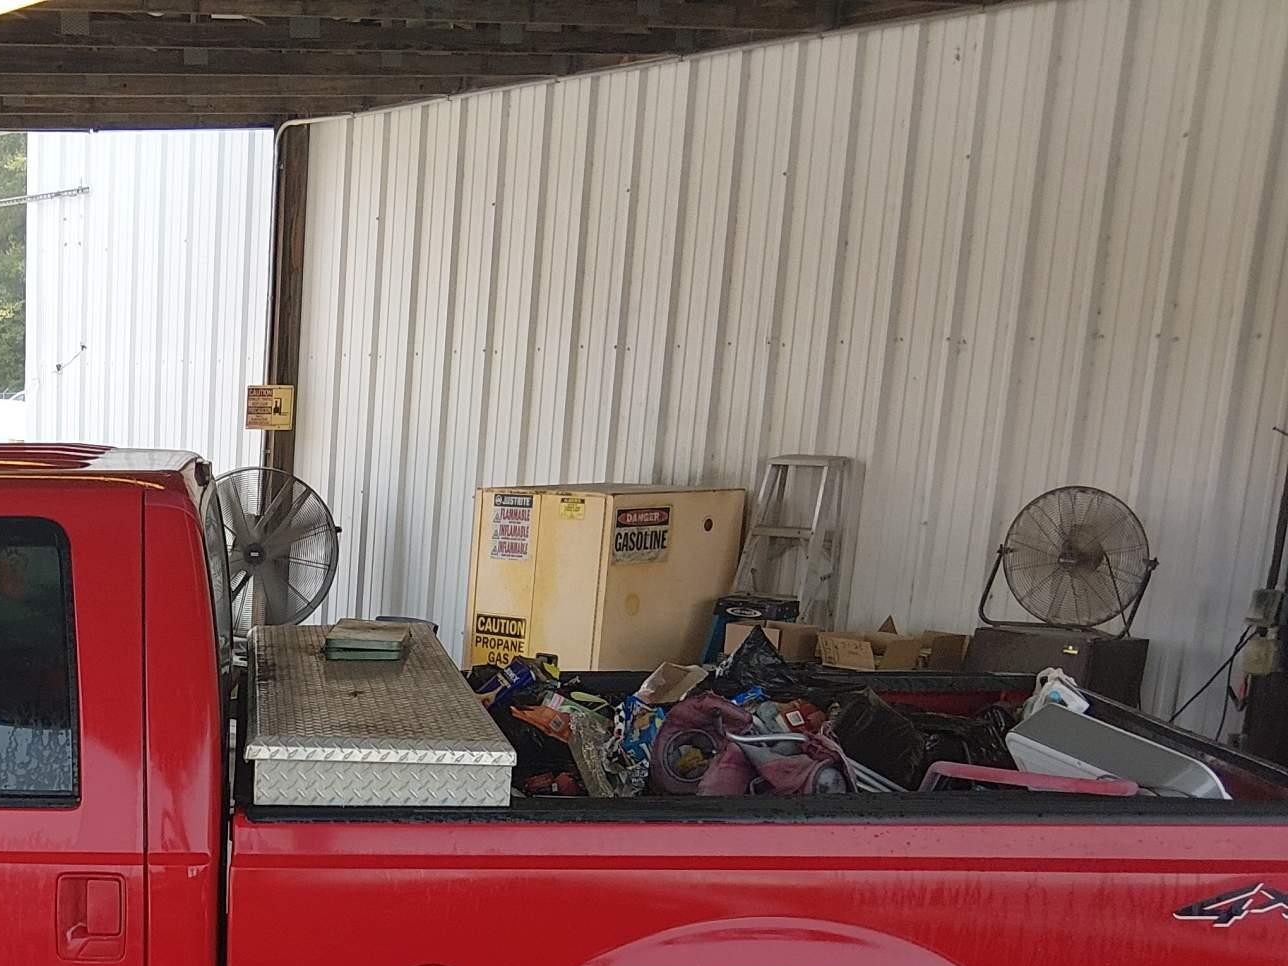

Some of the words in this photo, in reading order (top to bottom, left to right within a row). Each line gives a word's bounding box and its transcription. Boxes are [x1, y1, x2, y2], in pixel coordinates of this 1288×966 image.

[500, 508, 530, 521] FLAMMABLE
[626, 511, 660, 523] DANGER
[615, 529, 668, 552] GASOLINE
[477, 616, 525, 636] CAUTION
[475, 635, 525, 653] PROPANE
[488, 651, 509, 665] GAS
